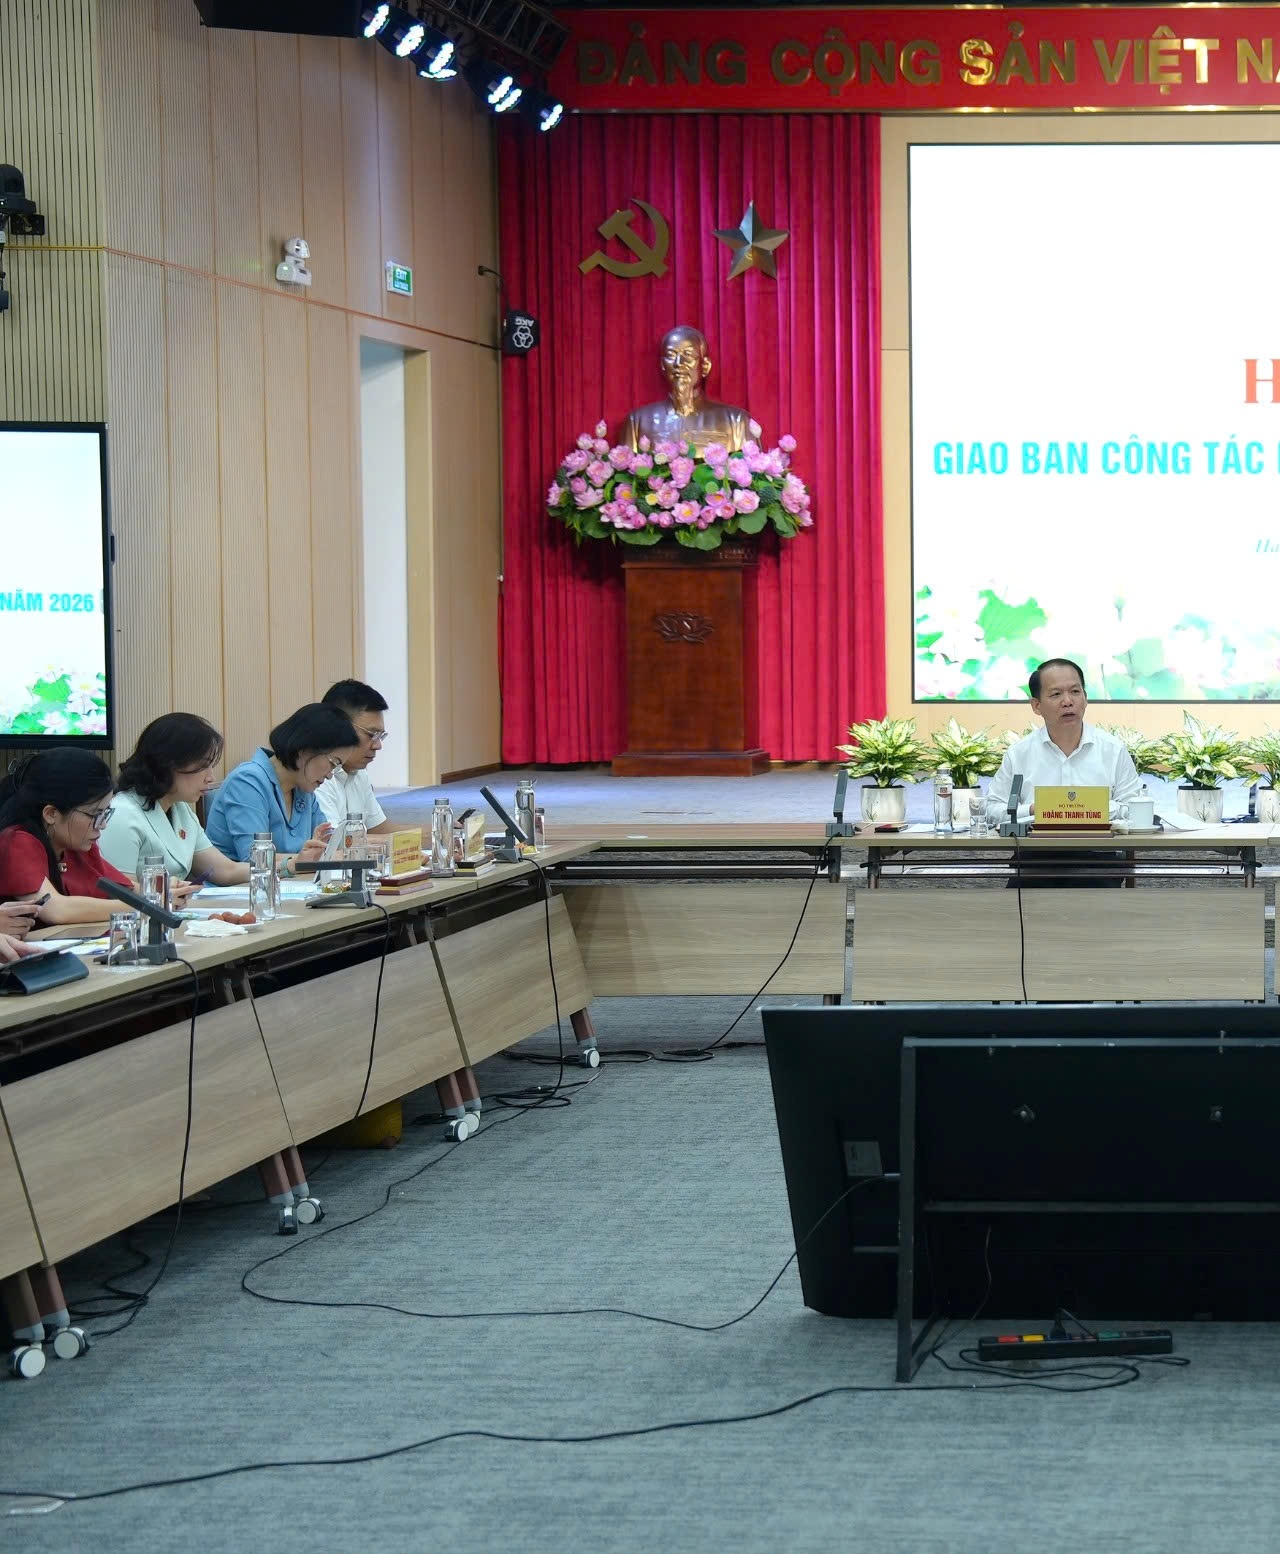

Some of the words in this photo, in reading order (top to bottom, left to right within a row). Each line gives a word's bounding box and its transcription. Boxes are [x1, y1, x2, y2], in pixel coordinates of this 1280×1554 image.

[575, 21, 746, 86] ĐẢNG
[771, 27, 944, 97] CỘNG
[959, 21, 1077, 86] SẢN
[1091, 26, 1219, 95] VIỆT
[933, 441, 1009, 475] GIAO
[1021, 441, 1089, 474] BAN
[1101, 433, 1192, 475] CÔNG
[1203, 433, 1265, 475] TÁC
[0, 588, 43, 612] NĂM
[49, 593, 95, 612] 2026
[1042, 810, 1064, 819] HOÀNG
[1064, 811, 1085, 819] THANH
[1086, 810, 1102, 819] TÙNG
